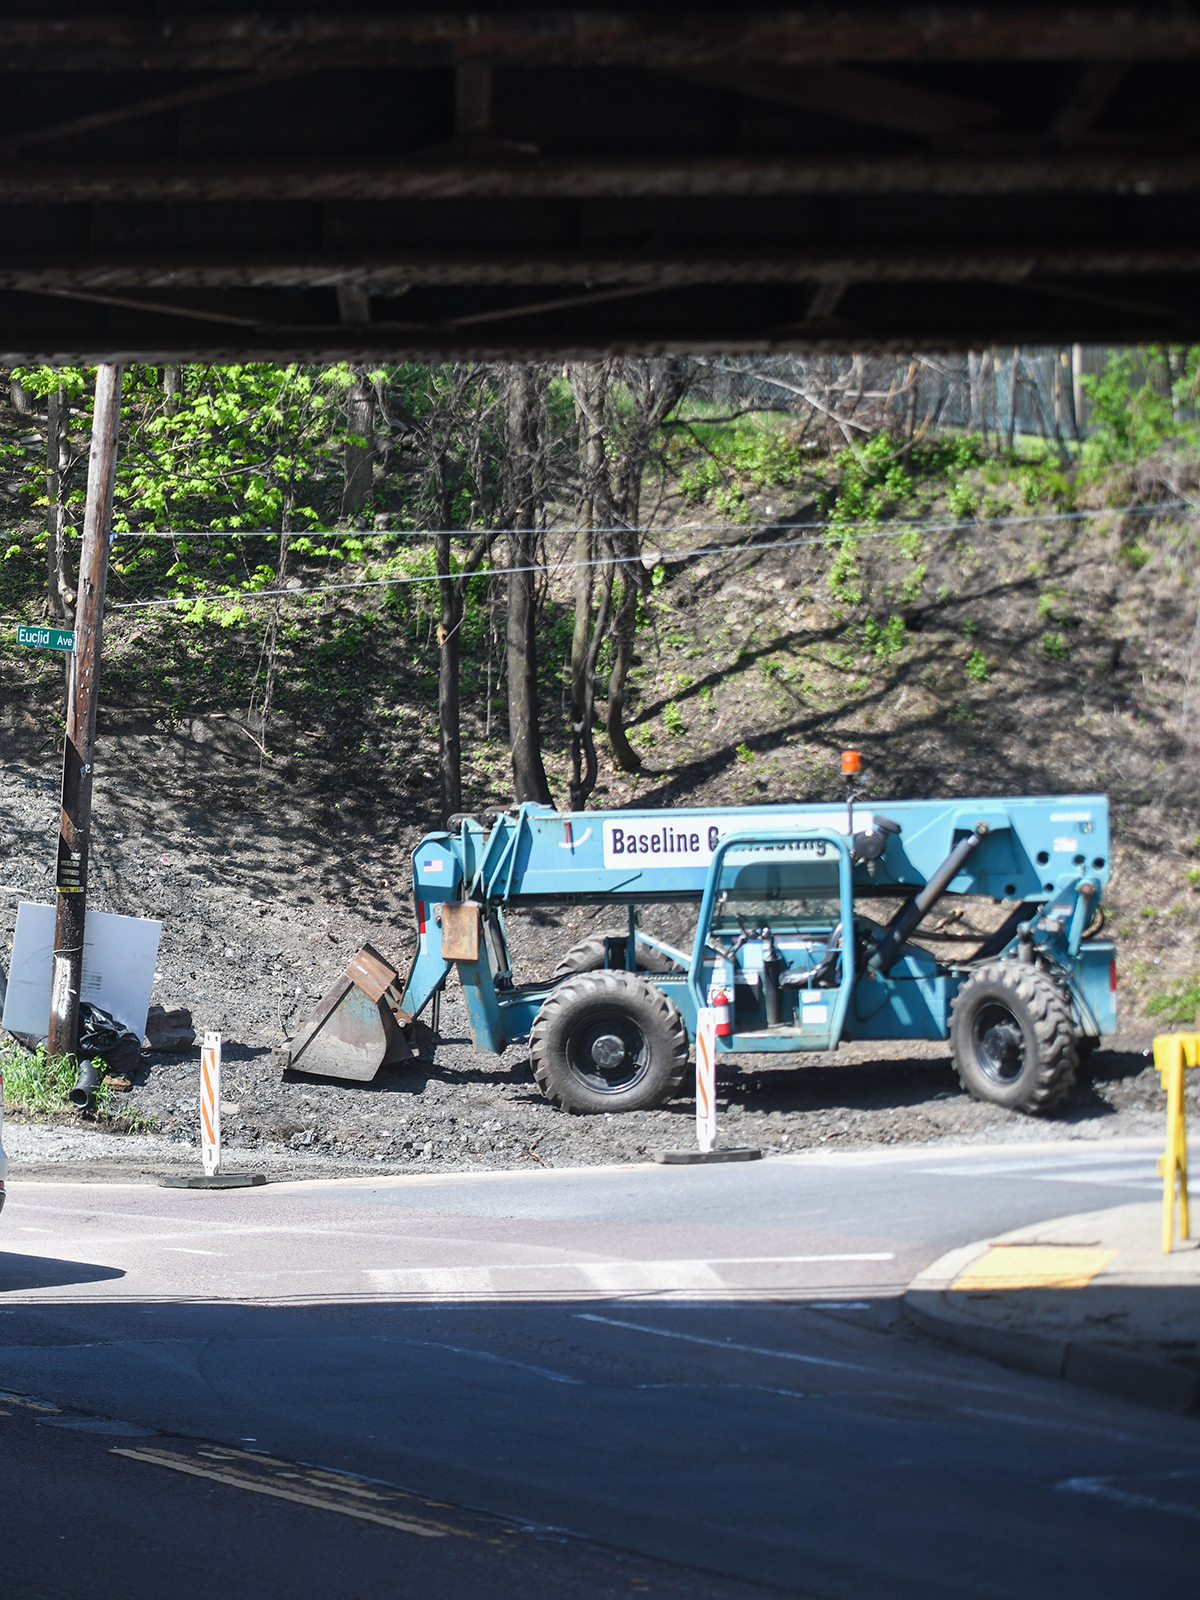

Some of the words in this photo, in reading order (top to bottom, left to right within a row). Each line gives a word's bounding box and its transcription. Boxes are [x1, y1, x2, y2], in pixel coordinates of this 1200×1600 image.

[19, 628, 50, 644] Euclid
[56, 635, 73, 646] Ave
[612, 827, 700, 854] Baseline
